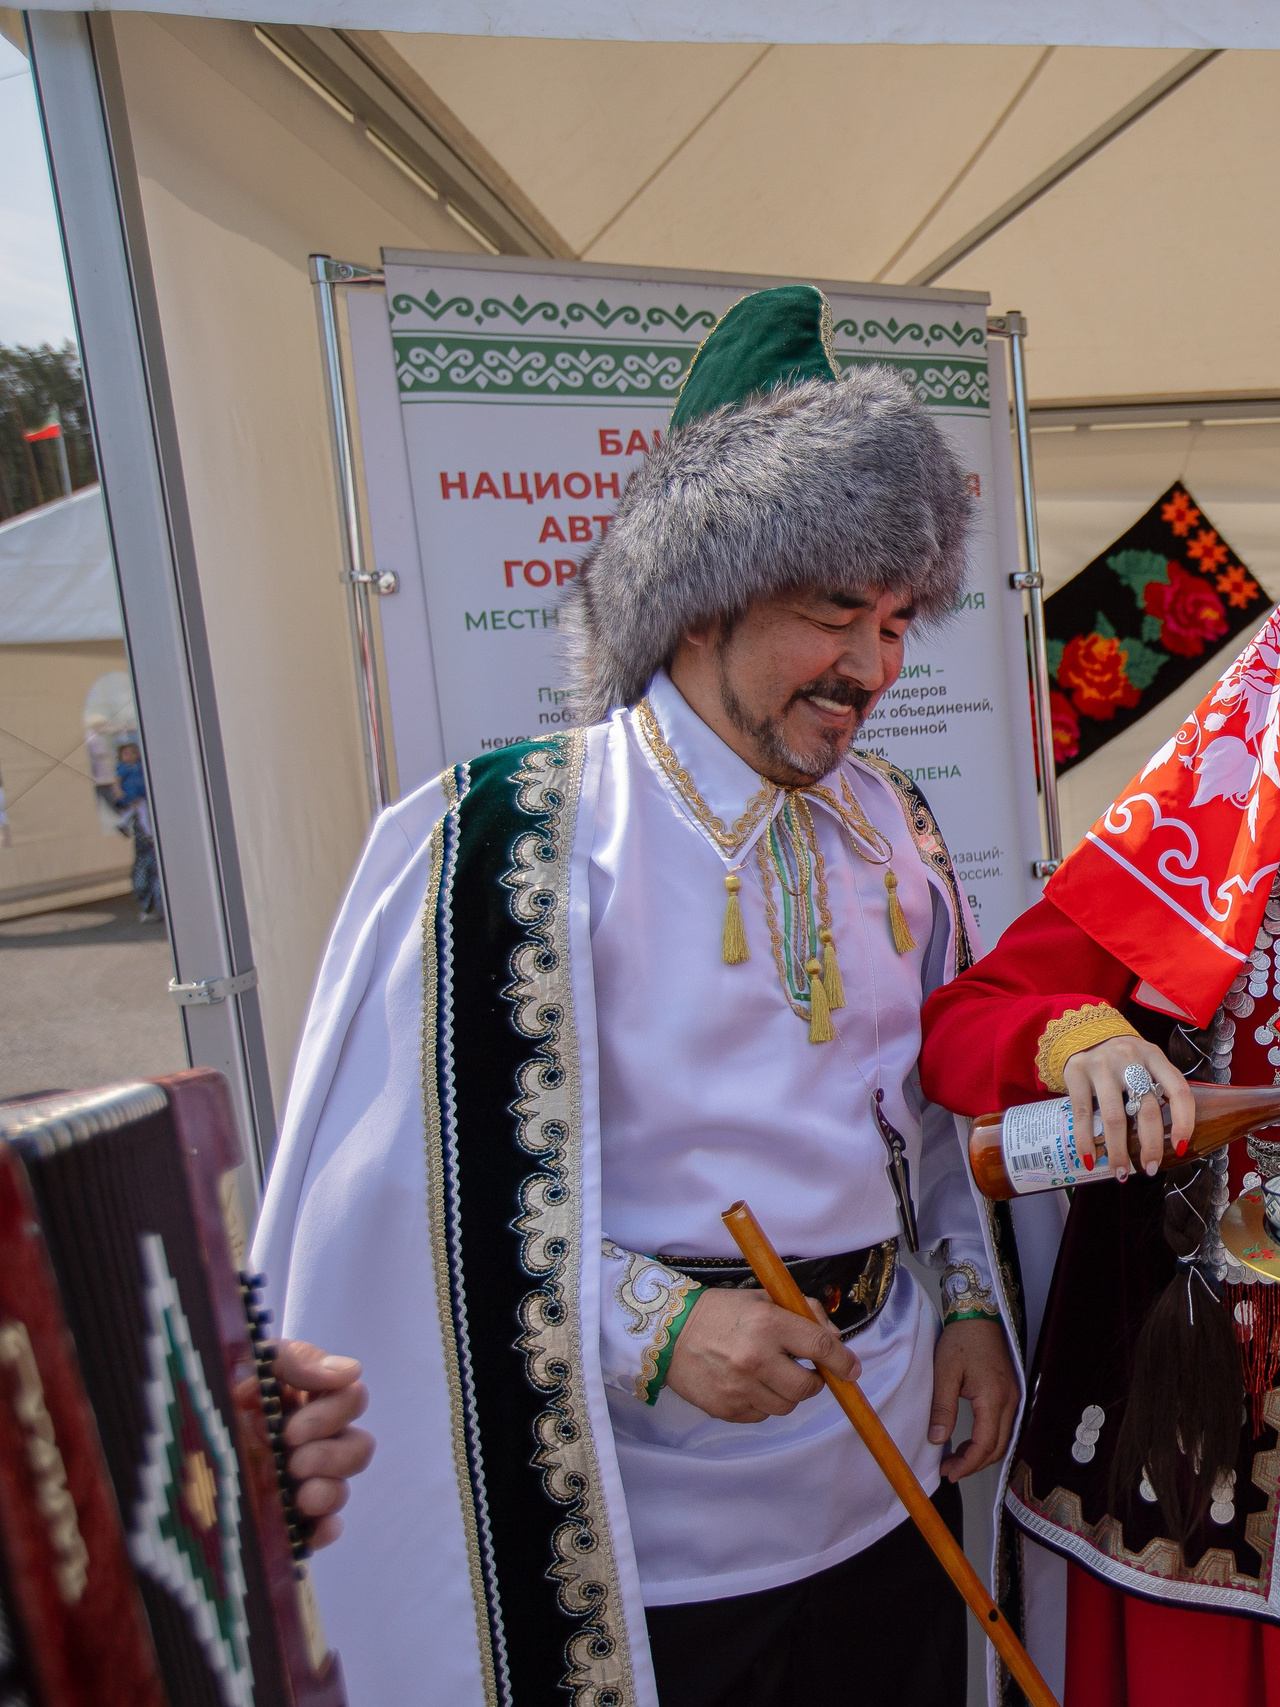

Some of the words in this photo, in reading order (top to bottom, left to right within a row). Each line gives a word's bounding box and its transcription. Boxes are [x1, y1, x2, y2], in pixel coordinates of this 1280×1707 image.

[439, 471, 630, 504] НАЦИОН
[465, 608, 560, 631] МЕСТН
[890, 698, 994, 718] объединений,
[904, 765, 961, 781] ВЛЕНА
